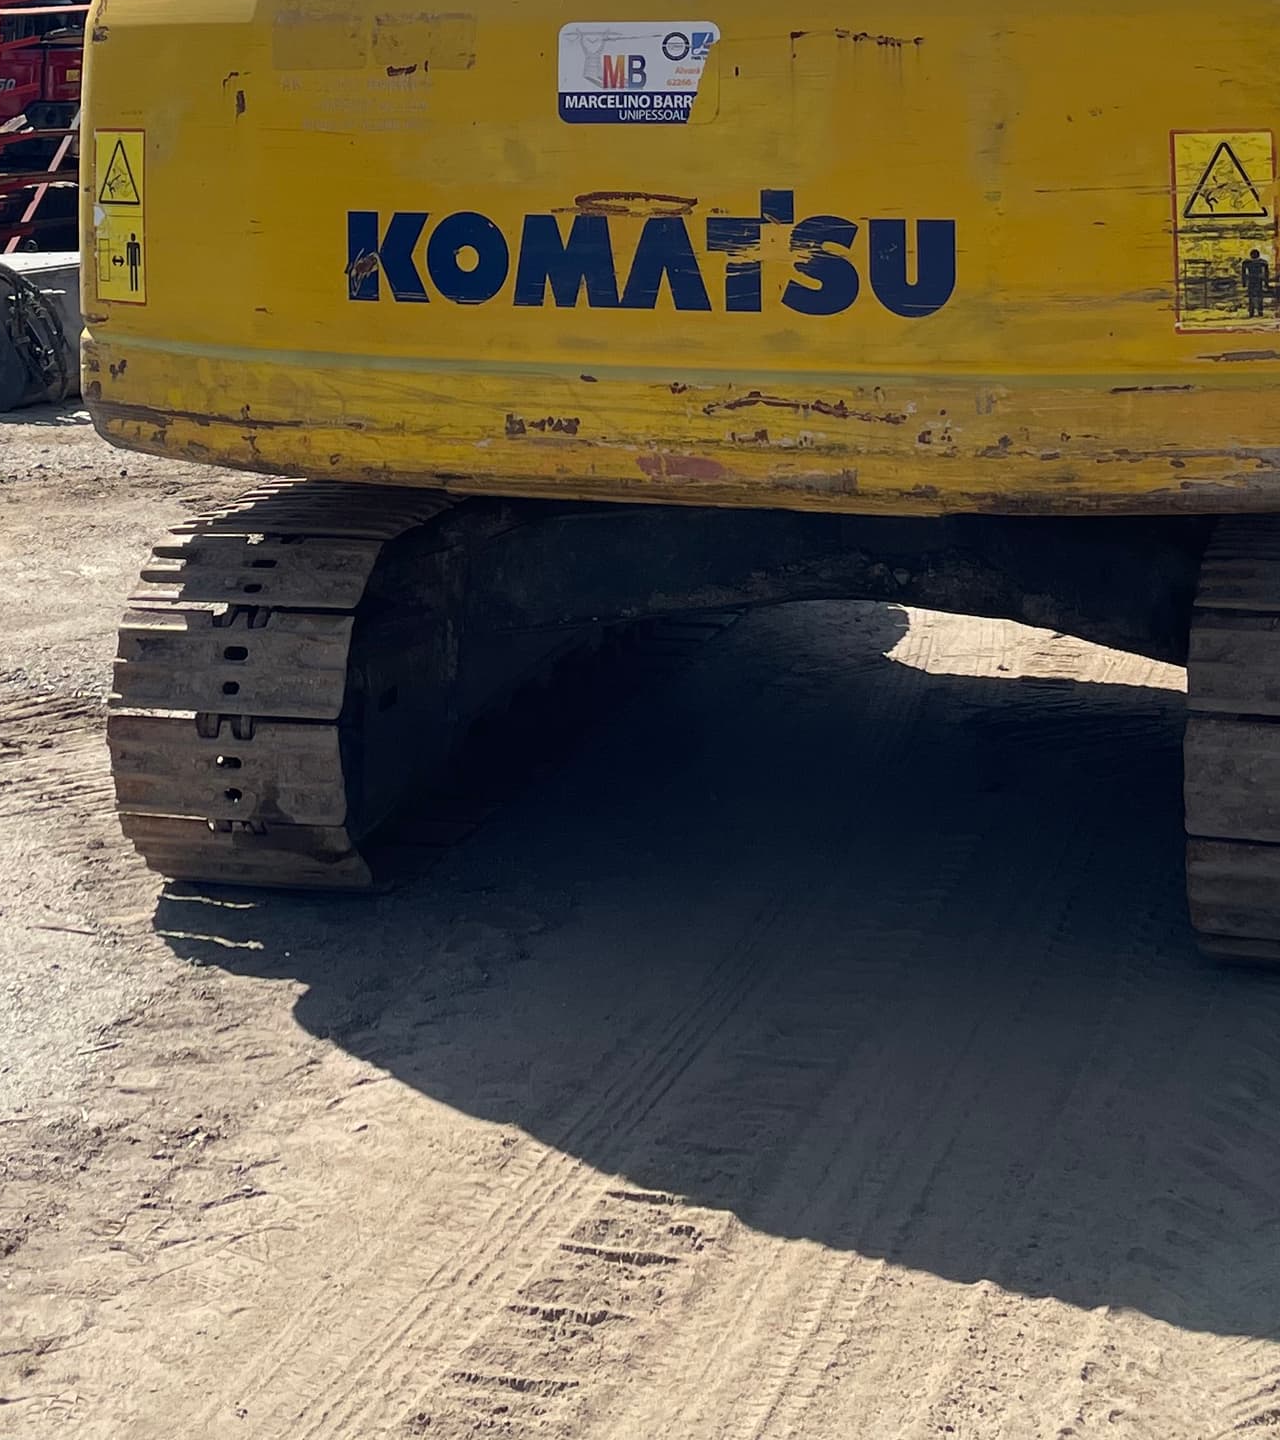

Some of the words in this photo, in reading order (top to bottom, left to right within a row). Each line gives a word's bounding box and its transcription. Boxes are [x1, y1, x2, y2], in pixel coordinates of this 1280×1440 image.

[602, 54, 647, 89] MB
[565, 95, 651, 109] MARCELINO
[653, 95, 694, 109] BARR
[619, 109, 687, 121] UNIPESSOAL
[346, 189, 956, 319] KOMATSU
